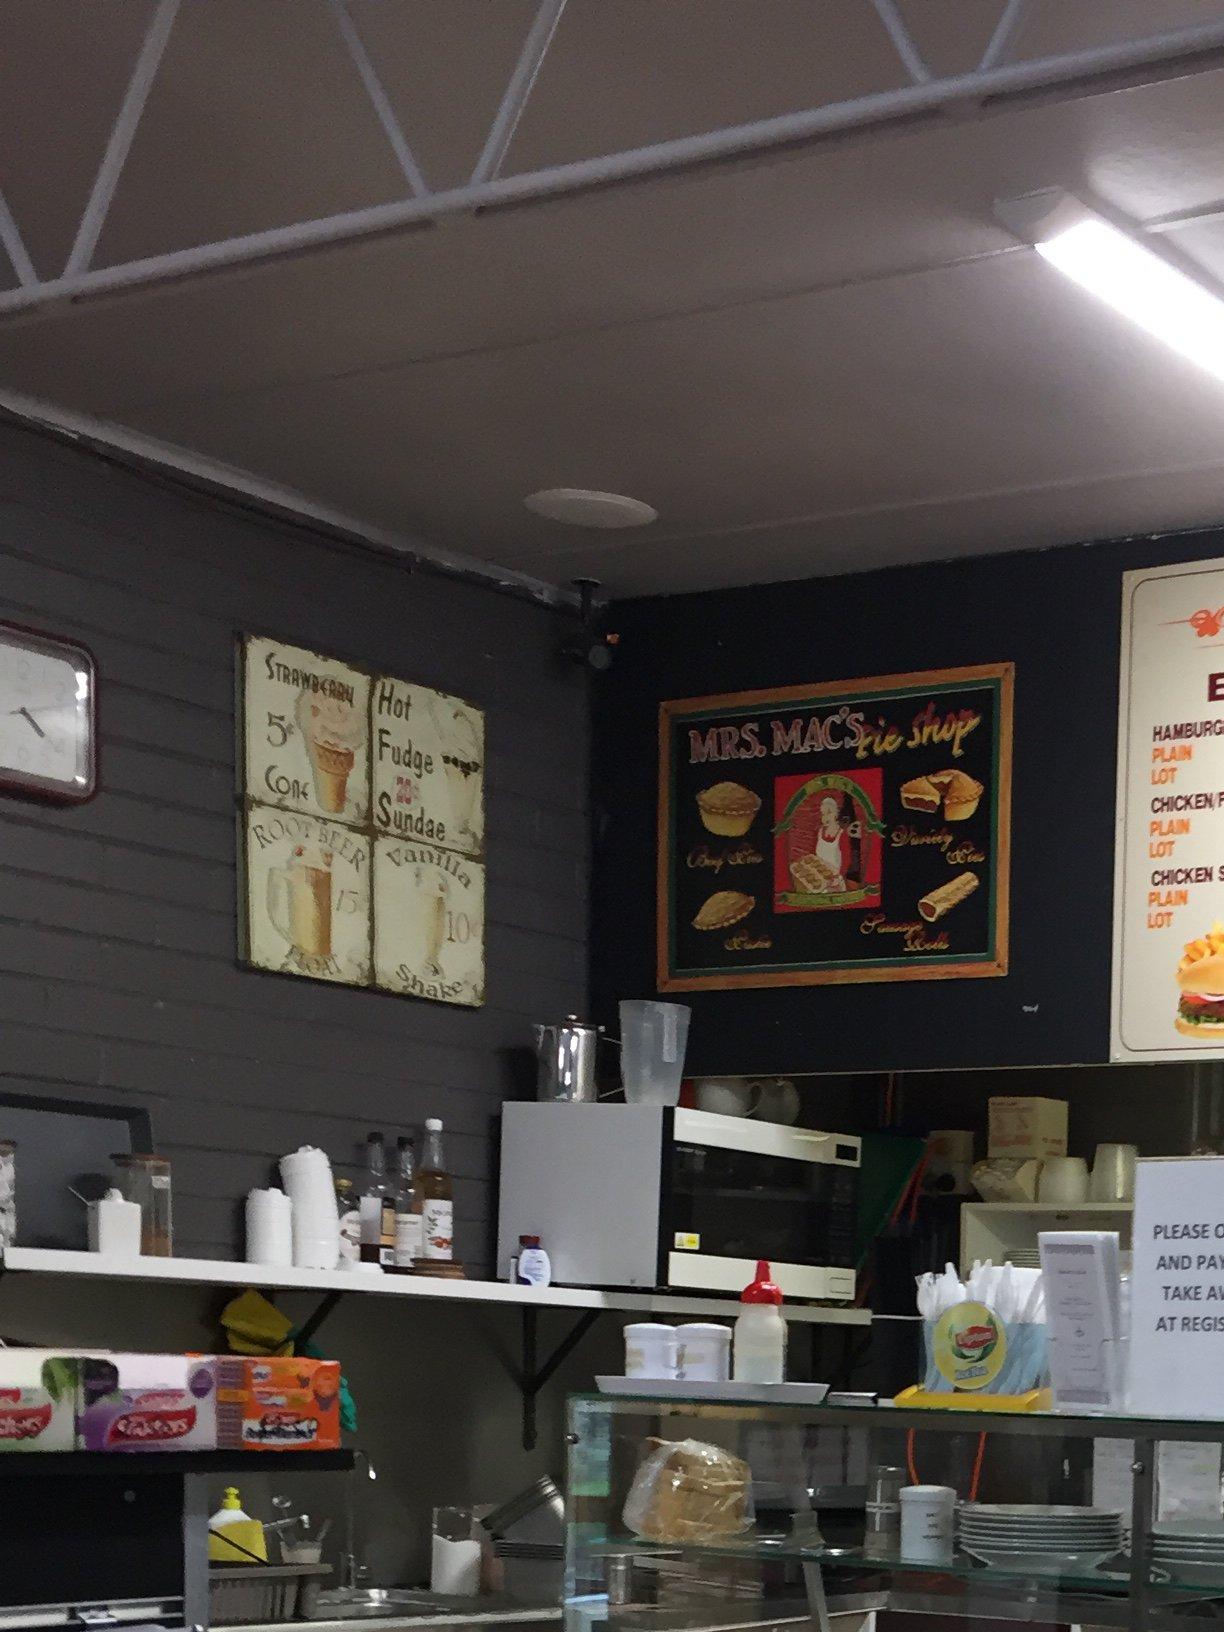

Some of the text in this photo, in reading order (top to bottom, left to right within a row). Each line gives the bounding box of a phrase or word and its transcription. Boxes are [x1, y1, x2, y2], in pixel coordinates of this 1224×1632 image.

[377, 680, 412, 721] Hot
[689, 706, 865, 764] MRS. MAC'S
[377, 728, 433, 780] Fudge
[1152, 745, 1193, 763] PLAIN
[1151, 767, 1177, 785] LOT
[376, 791, 446, 841] Sundae
[1149, 819, 1190, 836] PLAIN
[1148, 840, 1175, 858] LOT
[1151, 867, 1213, 887] CHICKEN
[1148, 890, 1188, 906] PLAIN
[1147, 911, 1173, 928] LOT
[1153, 1223, 1210, 1240] PLEASE
[1156, 1255, 1192, 1270] AND
[1162, 1286, 1202, 1301] TAKE
[1155, 1316, 1177, 1332] AT
